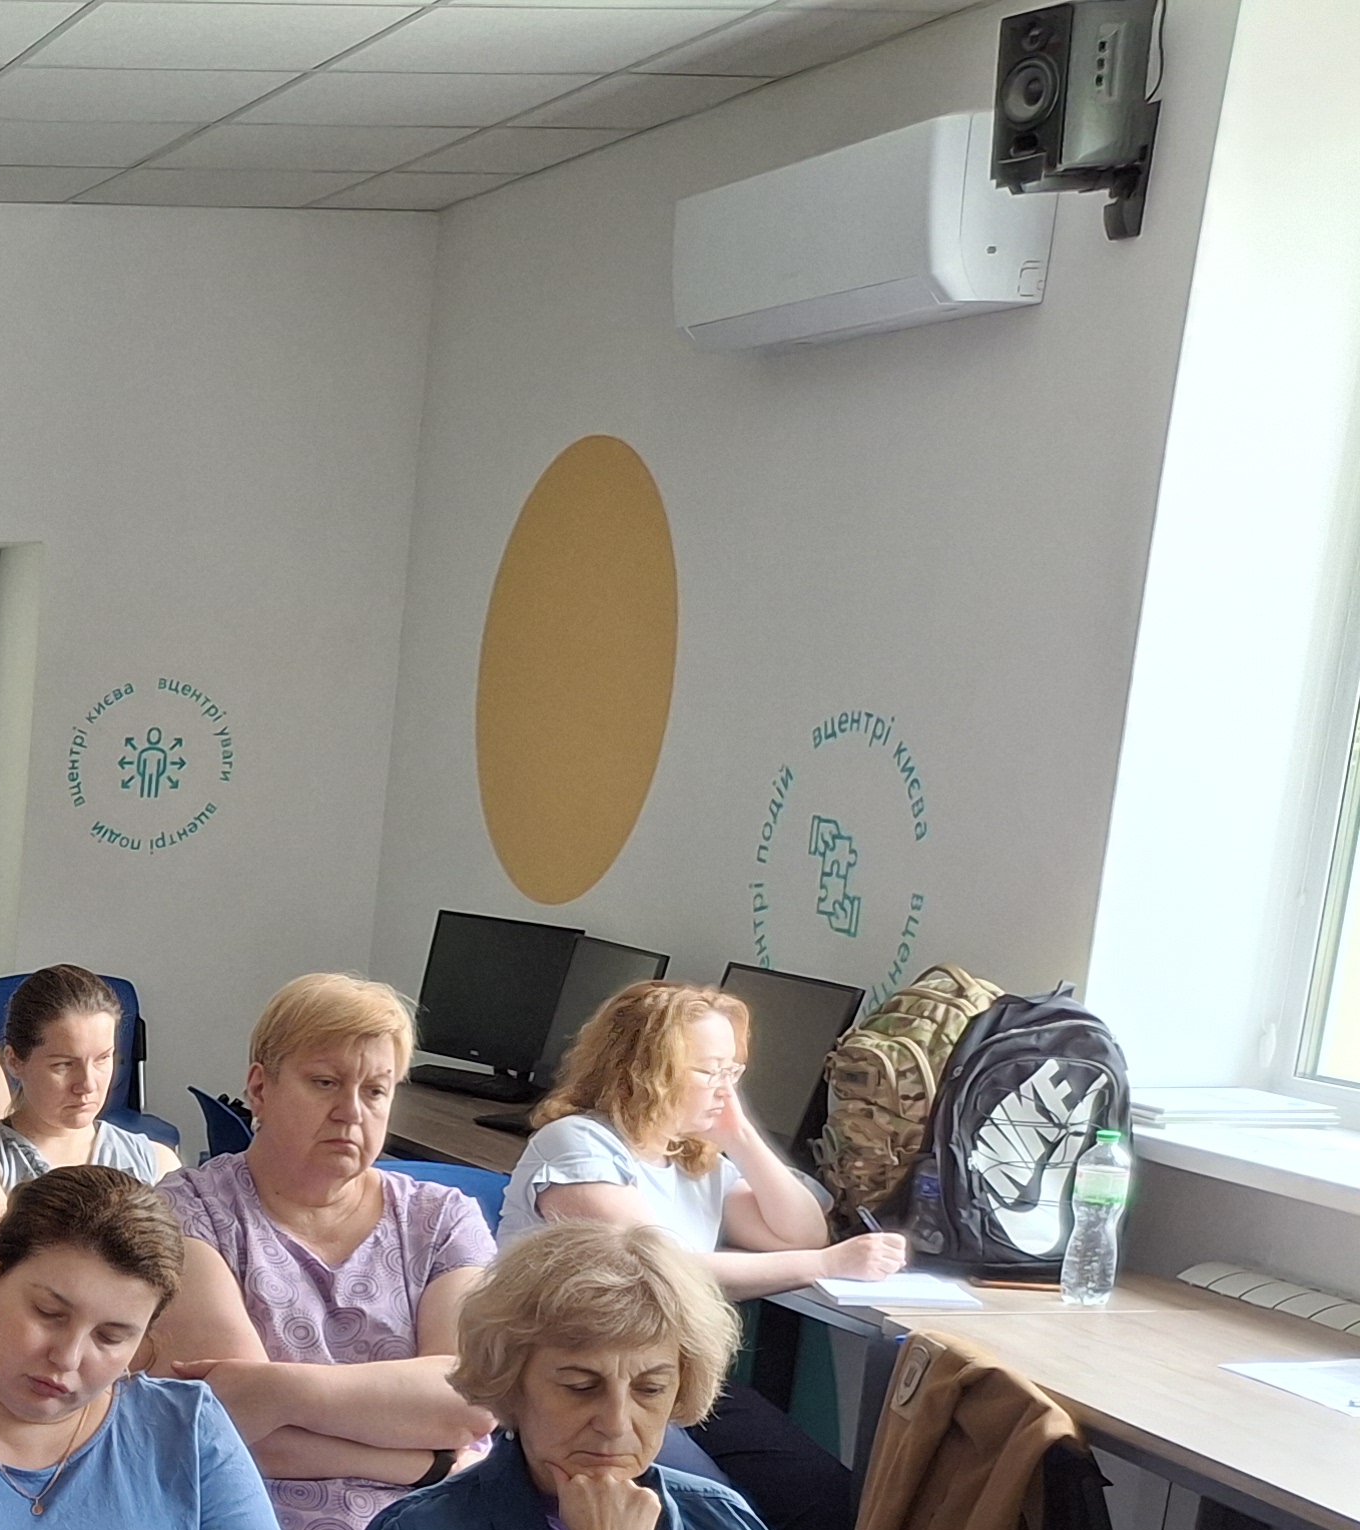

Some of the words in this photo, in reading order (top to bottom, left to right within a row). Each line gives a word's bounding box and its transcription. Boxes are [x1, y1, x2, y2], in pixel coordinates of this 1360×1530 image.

[68, 726, 88, 807] вцентрі
[85, 682, 135, 724] києва
[157, 677, 227, 723] вцентрі
[212, 726, 234, 782] уваги
[812, 710, 895, 749] вцентрі
[892, 741, 928, 842] києва
[90, 820, 141, 851] подій
[149, 802, 218, 855] вцентрі
[757, 764, 793, 864] подій
[748, 882, 773, 971] ентрі
[977, 1058, 1072, 1204] NIKE
